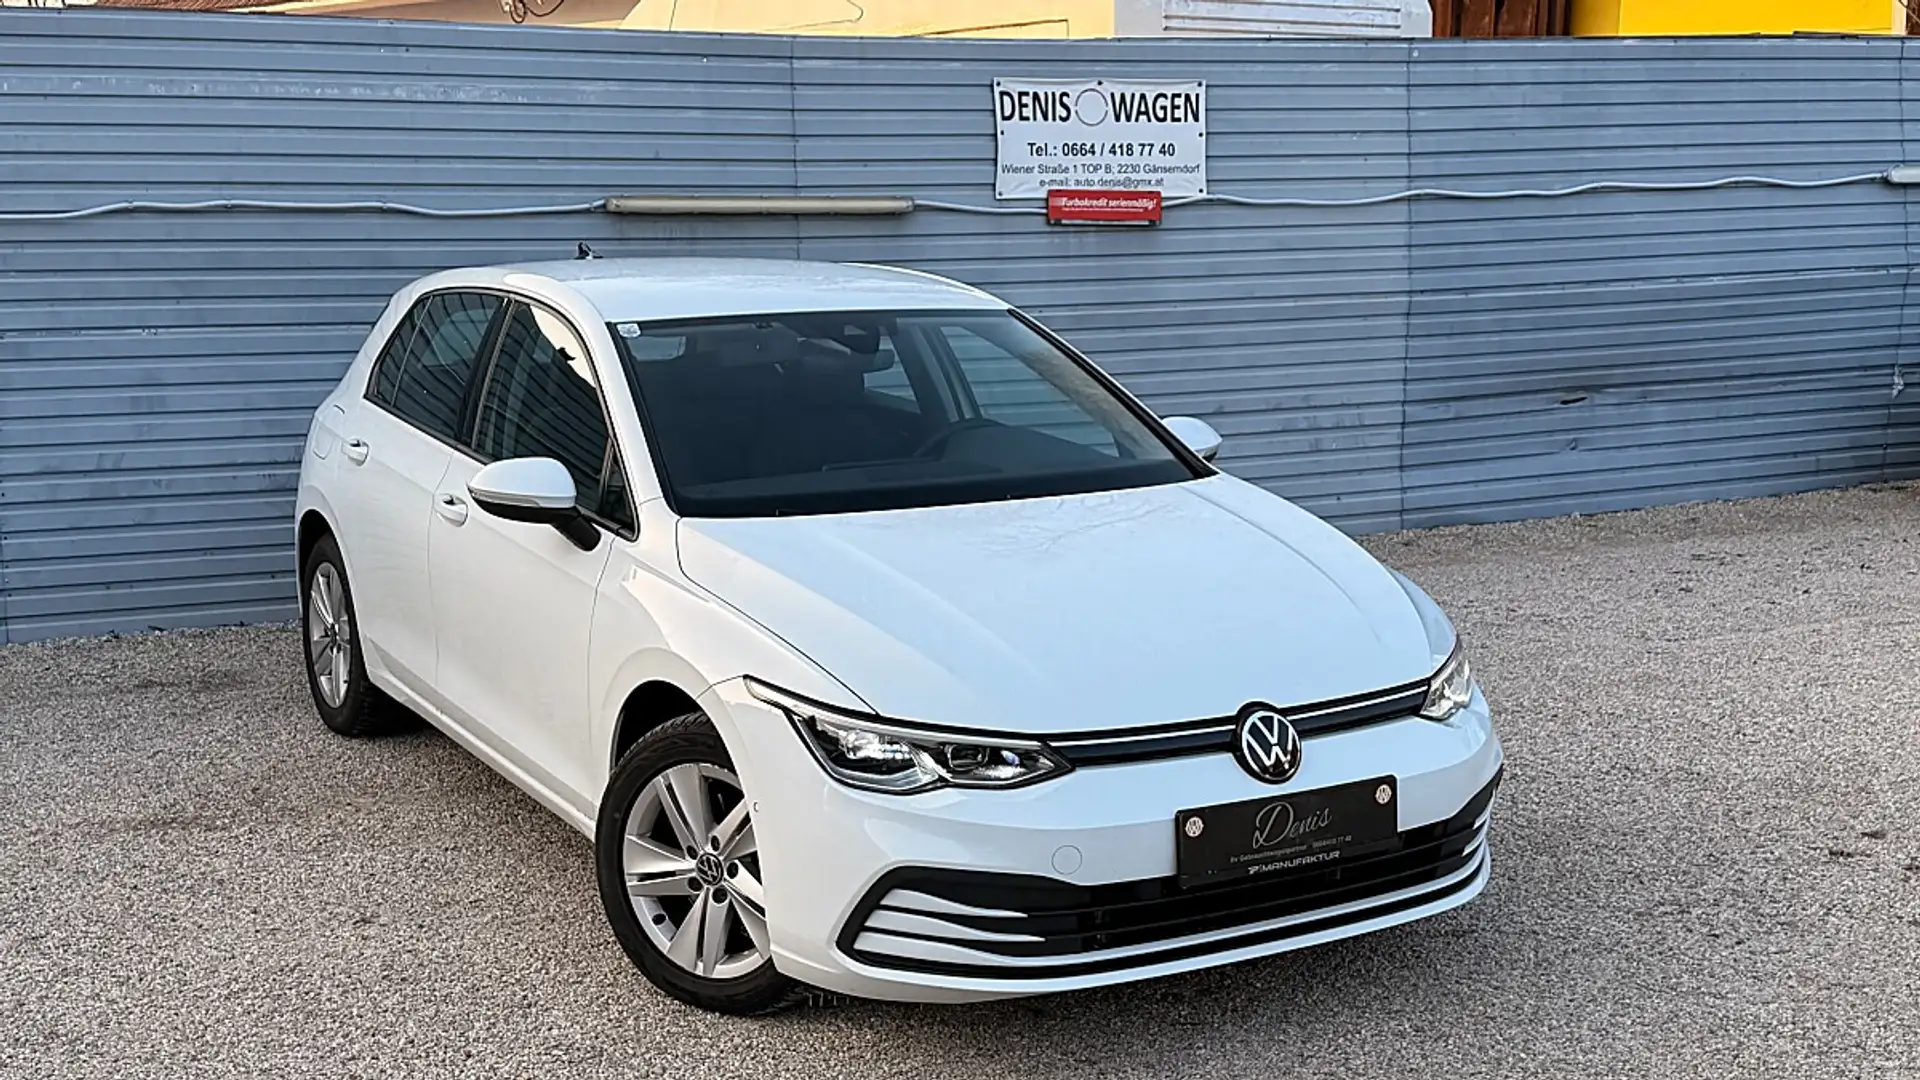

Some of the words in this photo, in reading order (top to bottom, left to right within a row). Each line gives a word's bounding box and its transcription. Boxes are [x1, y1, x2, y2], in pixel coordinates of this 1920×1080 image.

[999, 91, 1072, 122] DENIS
[1110, 92, 1200, 123] WAGEN
[1027, 142, 1058, 156] Tel.:
[1062, 142, 1096, 156] 0664
[1099, 142, 1105, 156] /
[1109, 143, 1134, 156] 418
[1138, 143, 1154, 156] 77
[1158, 143, 1175, 156] 40
[1001, 163, 1035, 174] Wiener
[1037, 163, 1070, 174] Straße
[1073, 164, 1078, 174] 1
[1080, 163, 1102, 174] TOP
[1117, 163, 1140, 174] 2230
[1252, 801, 1332, 849] Denis
